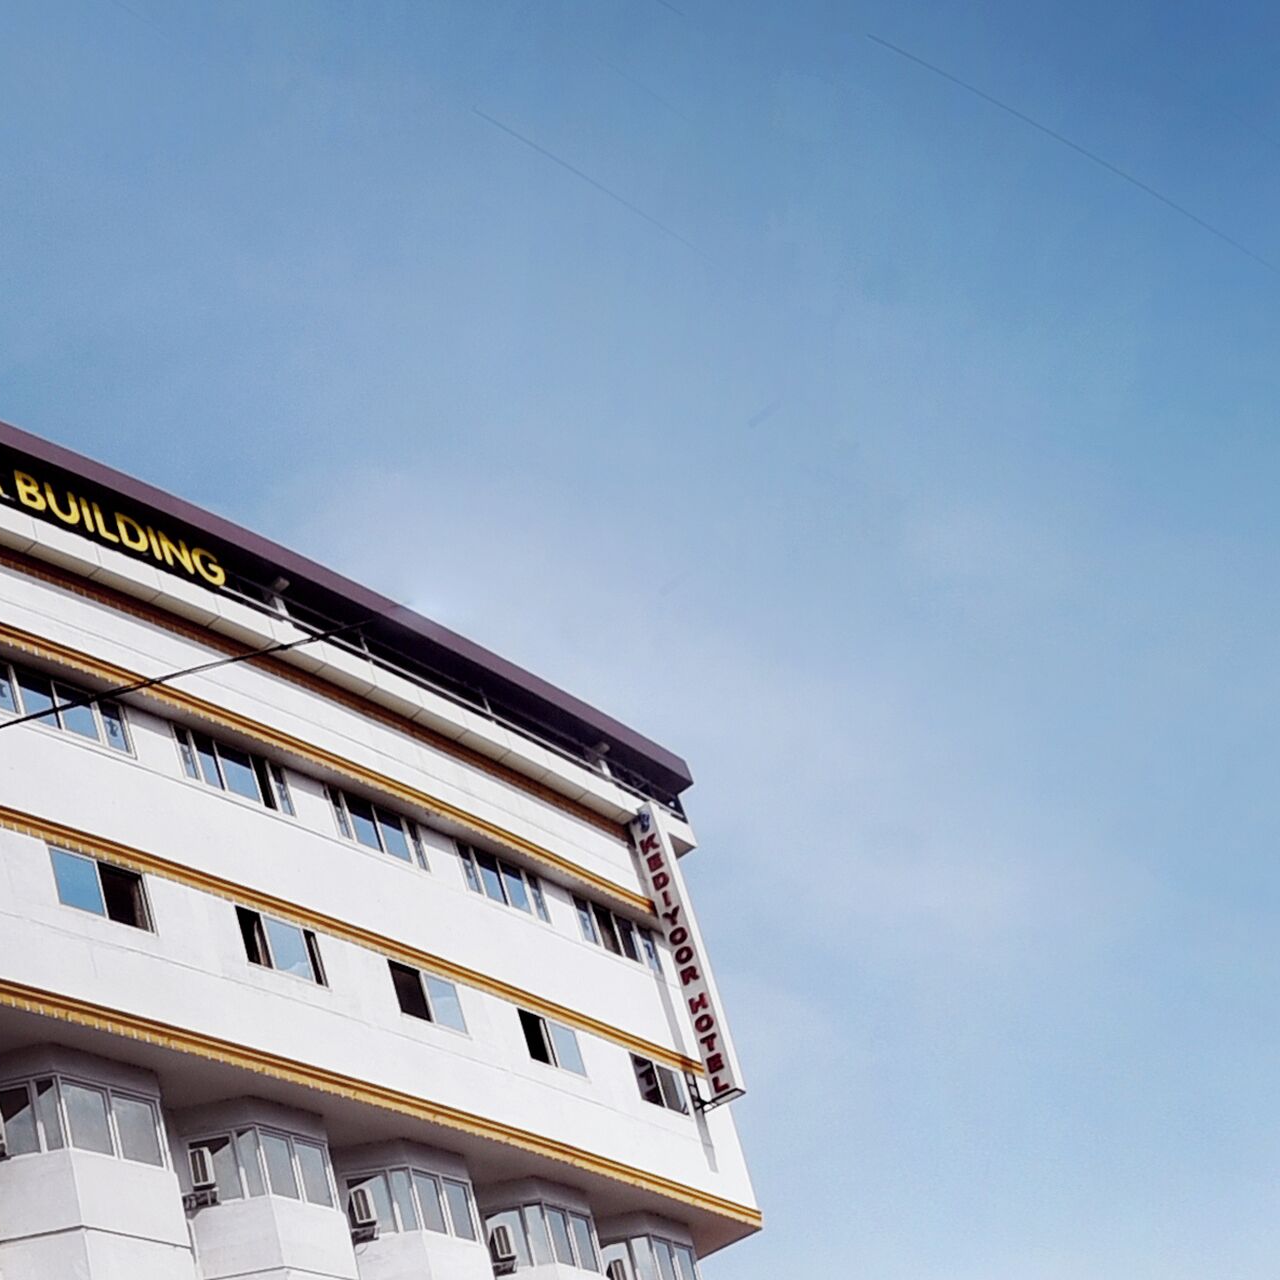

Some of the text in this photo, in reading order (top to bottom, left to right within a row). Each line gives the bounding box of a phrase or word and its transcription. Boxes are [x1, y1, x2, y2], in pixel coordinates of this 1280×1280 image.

[14, 470, 226, 587] BUILDING
[639, 832, 730, 1094] KEDIYOOR HOTEL
